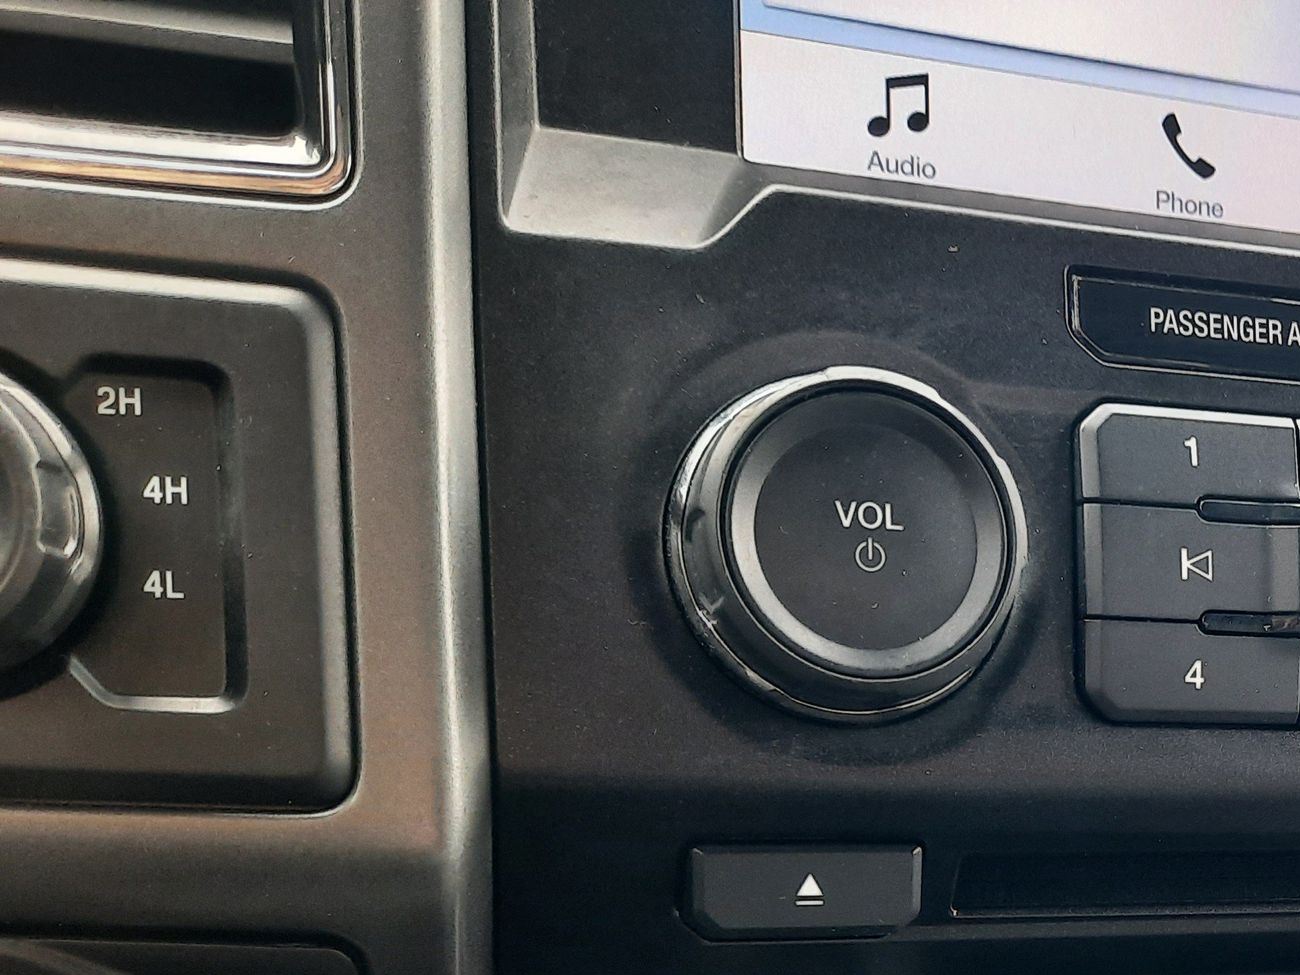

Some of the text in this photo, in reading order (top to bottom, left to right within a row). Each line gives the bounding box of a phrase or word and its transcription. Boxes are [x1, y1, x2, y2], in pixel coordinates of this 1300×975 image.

[867, 150, 936, 180] Audio
[1155, 190, 1224, 219] Phone
[1150, 307, 1284, 346] PASSENGER
[97, 386, 142, 416] 2H
[1184, 437, 1198, 466] 1
[143, 475, 188, 505] 4H
[835, 500, 904, 531] VOL
[143, 570, 185, 599] 4L
[1184, 660, 1205, 689] 4
